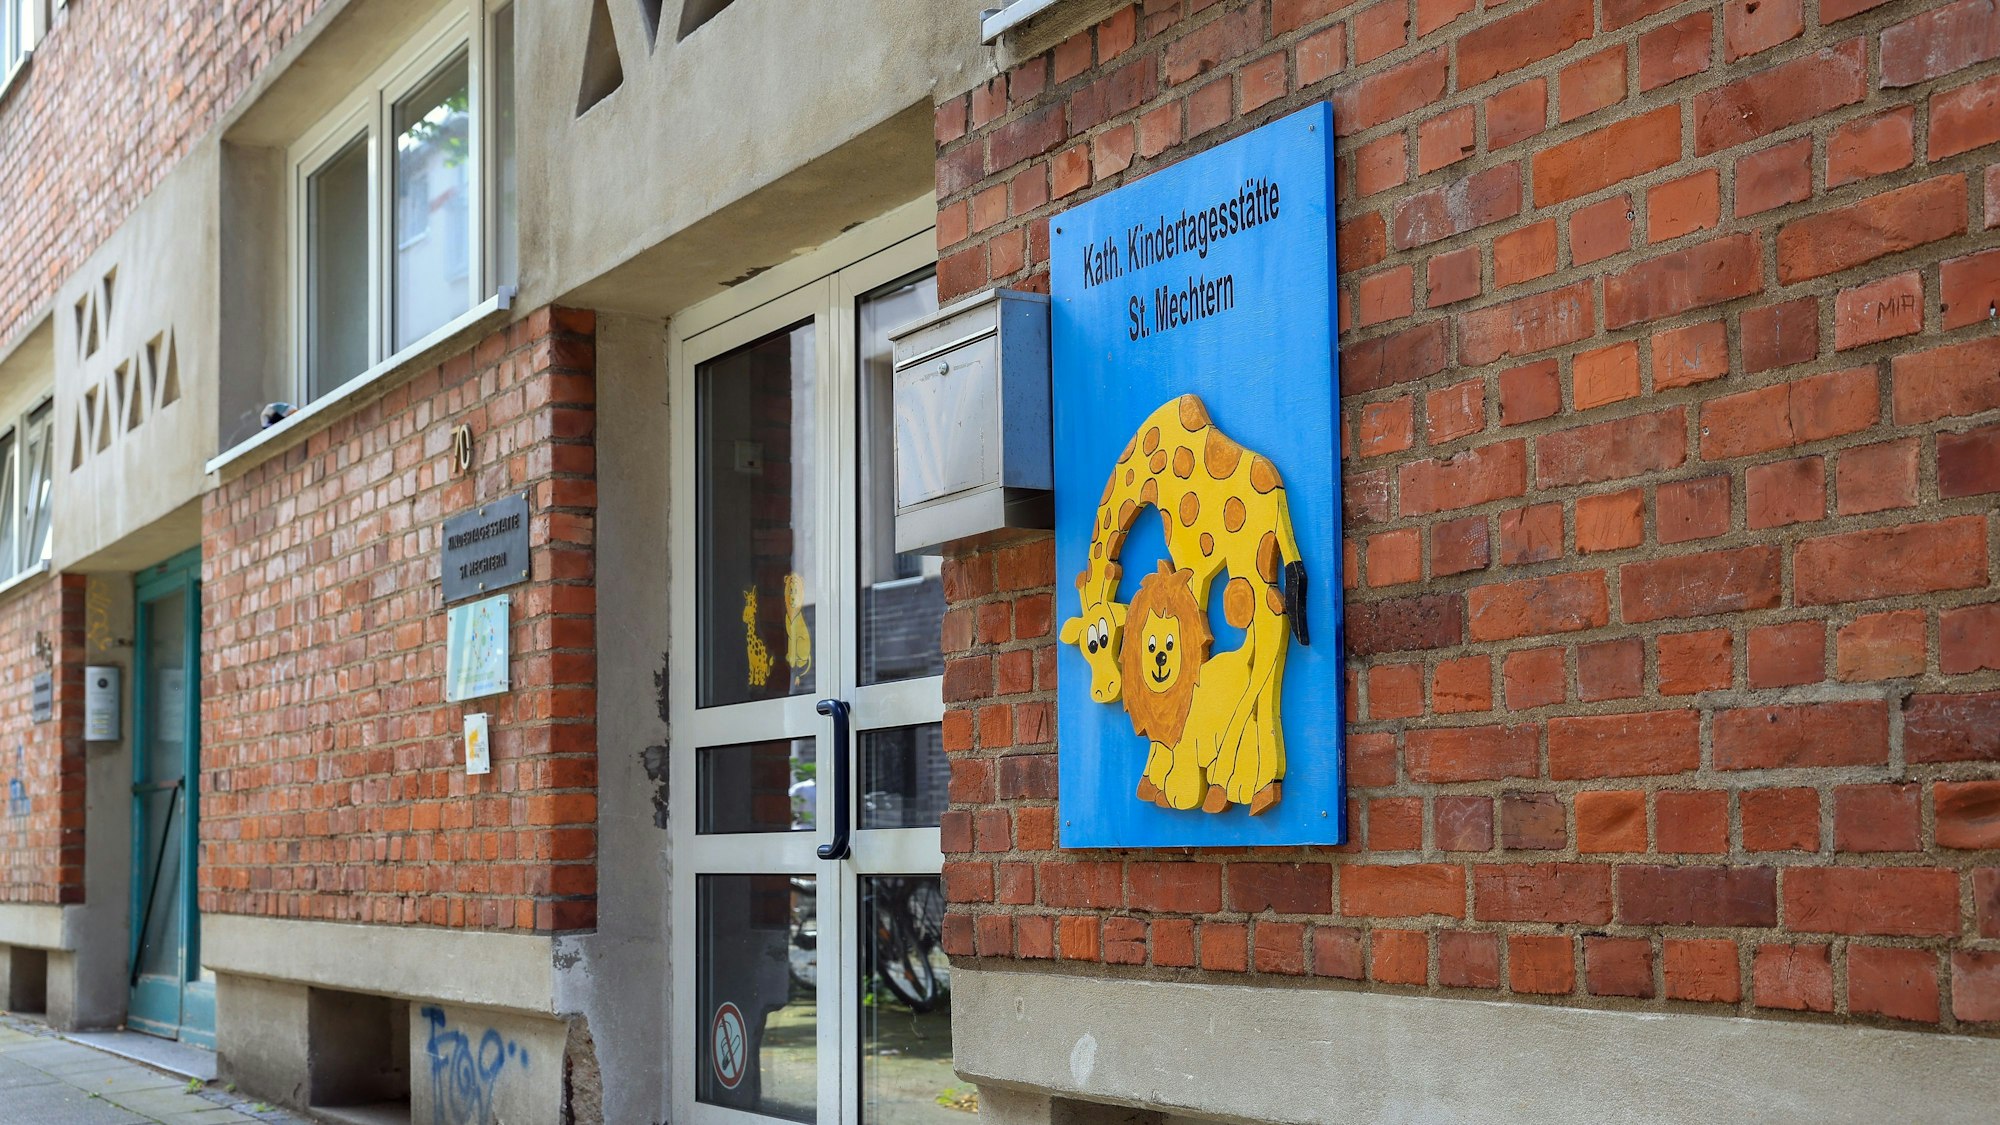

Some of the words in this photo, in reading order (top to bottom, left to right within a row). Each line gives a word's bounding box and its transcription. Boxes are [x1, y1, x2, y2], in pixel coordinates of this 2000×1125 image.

[1083, 235, 1124, 289] Kath.
[1127, 175, 1280, 272] Kindertagesstätte
[1129, 295, 1151, 341] St.
[1154, 273, 1235, 333] Mechtern
[450, 424, 470, 473] 70
